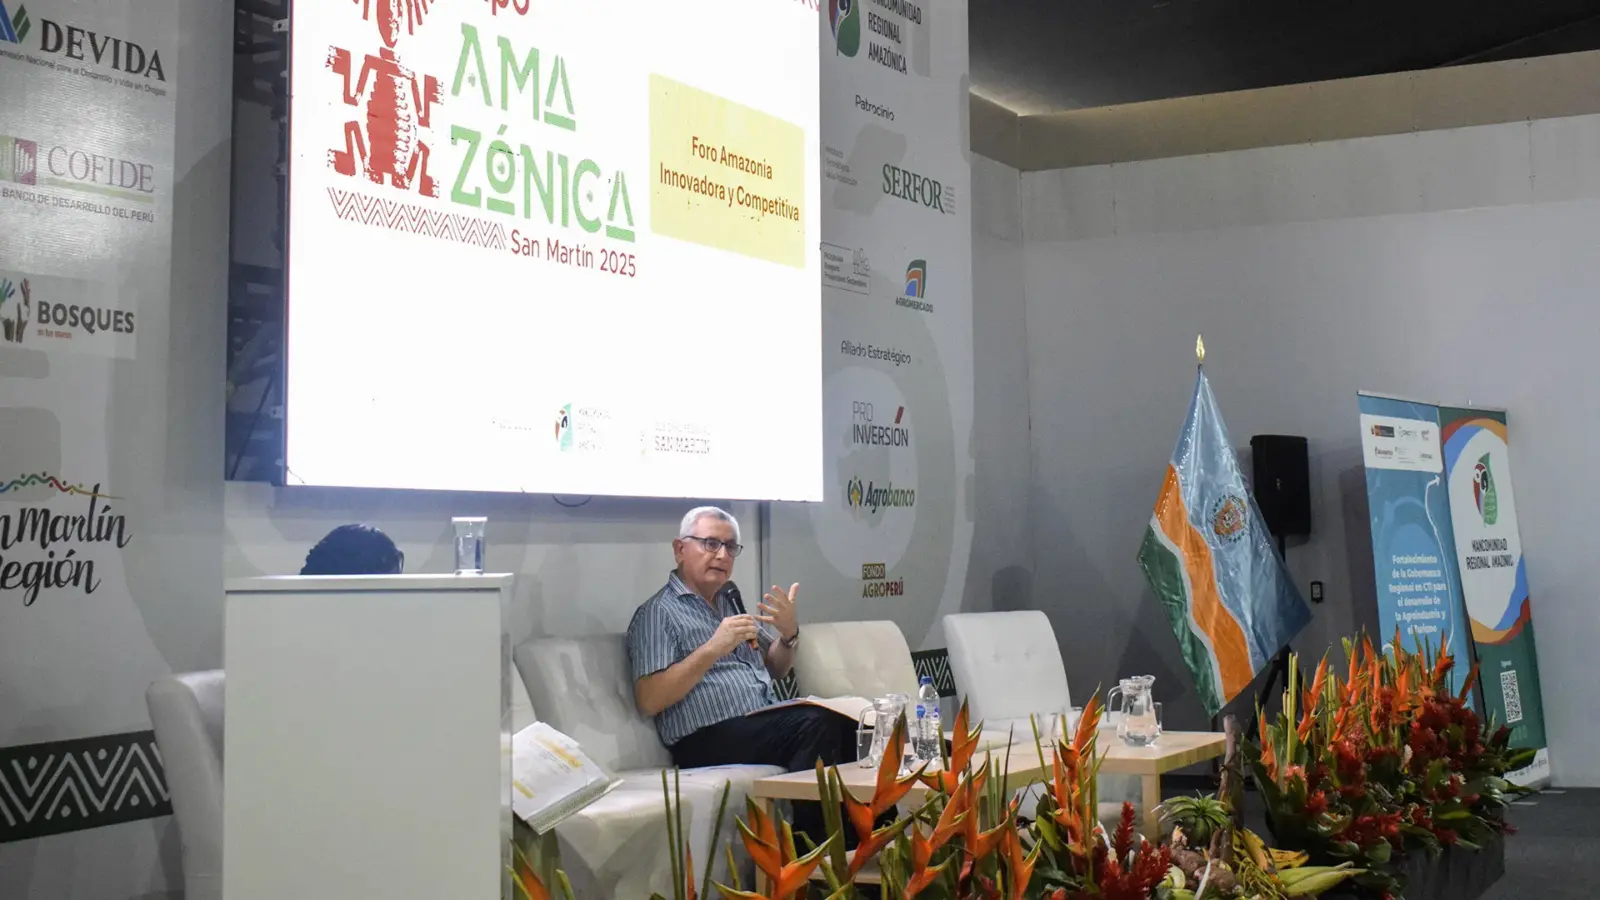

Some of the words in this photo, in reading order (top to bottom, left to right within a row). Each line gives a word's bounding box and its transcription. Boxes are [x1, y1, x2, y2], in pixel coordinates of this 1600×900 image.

[868, 12, 901, 44] REGIONAL
[40, 18, 166, 82] DEVIDA
[868, 41, 907, 75] AMAZÓNICA
[451, 22, 576, 132] AMA
[855, 94, 895, 121] Patrocinio
[47, 146, 156, 193] COFIDE
[691, 136, 718, 163] Foro
[719, 145, 773, 180] Amazonia
[451, 124, 636, 244] ZÓNICA
[660, 162, 726, 201] Innovadora
[727, 186, 735, 208] y
[736, 185, 800, 222] Competitiva
[882, 162, 945, 215] SERFOR
[2, 187, 36, 204] BANCO
[37, 194, 54, 206] DE
[52, 197, 111, 216] DESARROLLO
[112, 207, 131, 219] DEL
[131, 209, 154, 223] PERÚ
[510, 229, 541, 258] San
[546, 237, 594, 269] Martín
[600, 249, 636, 278] 2025
[37, 300, 135, 334] BOSQUES
[895, 296, 934, 314] AGROMERCADO
[841, 339, 866, 358] Aliado
[868, 344, 911, 367] Estratégico
[852, 400, 874, 422] PRO
[864, 480, 916, 514] Agrobanco
[17, 483, 132, 550] Martín
[863, 564, 885, 578] FONDO
[1393, 554, 1437, 565] Fortalecimiento
[1466, 557, 1490, 569] REGIONAL
[0, 549, 101, 607] egión
[862, 576, 904, 598] AGROPERÚ
